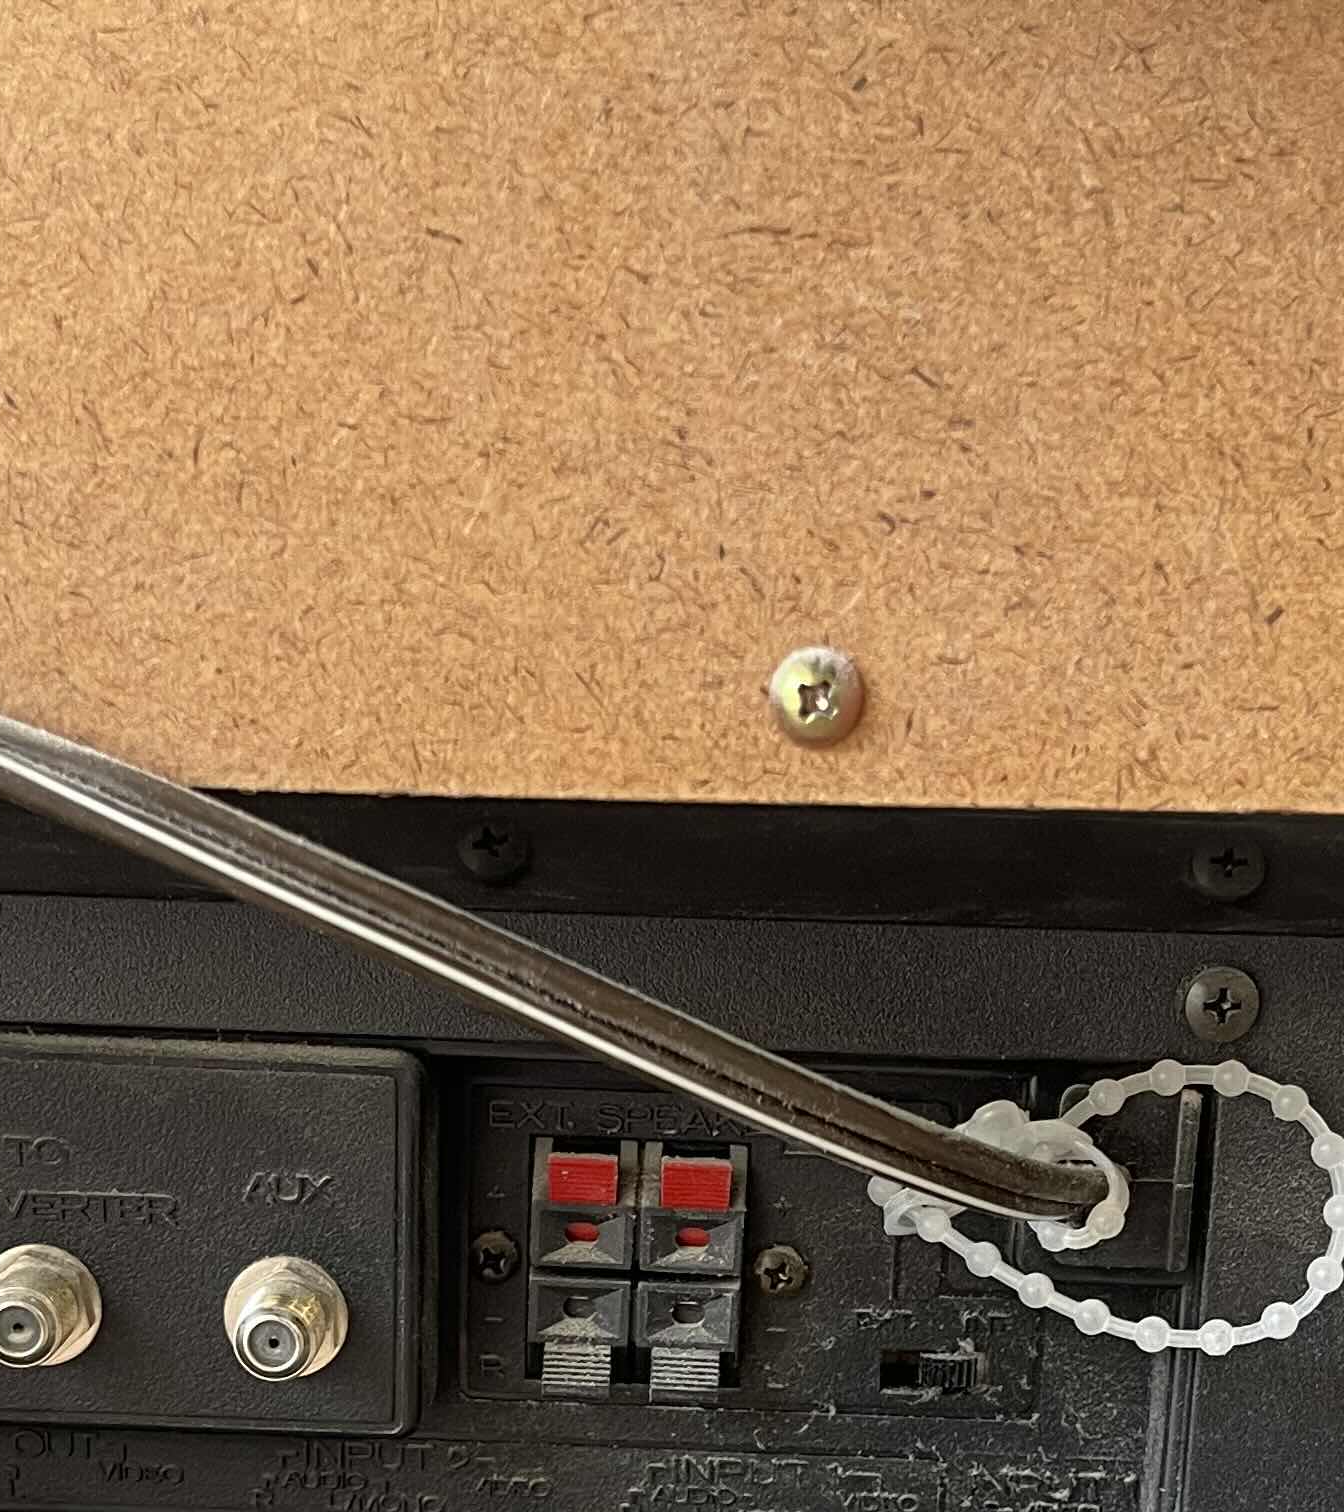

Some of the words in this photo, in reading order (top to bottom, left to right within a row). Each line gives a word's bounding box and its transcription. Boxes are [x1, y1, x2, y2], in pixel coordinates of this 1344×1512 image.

[597, 1103, 760, 1137] SPEAK
[2, 1133, 70, 1167] TO
[240, 1171, 332, 1205] AUX
[14, 1429, 100, 1458] OUT
[305, 1440, 435, 1471] INPUT
[672, 1454, 809, 1486] INPUT
